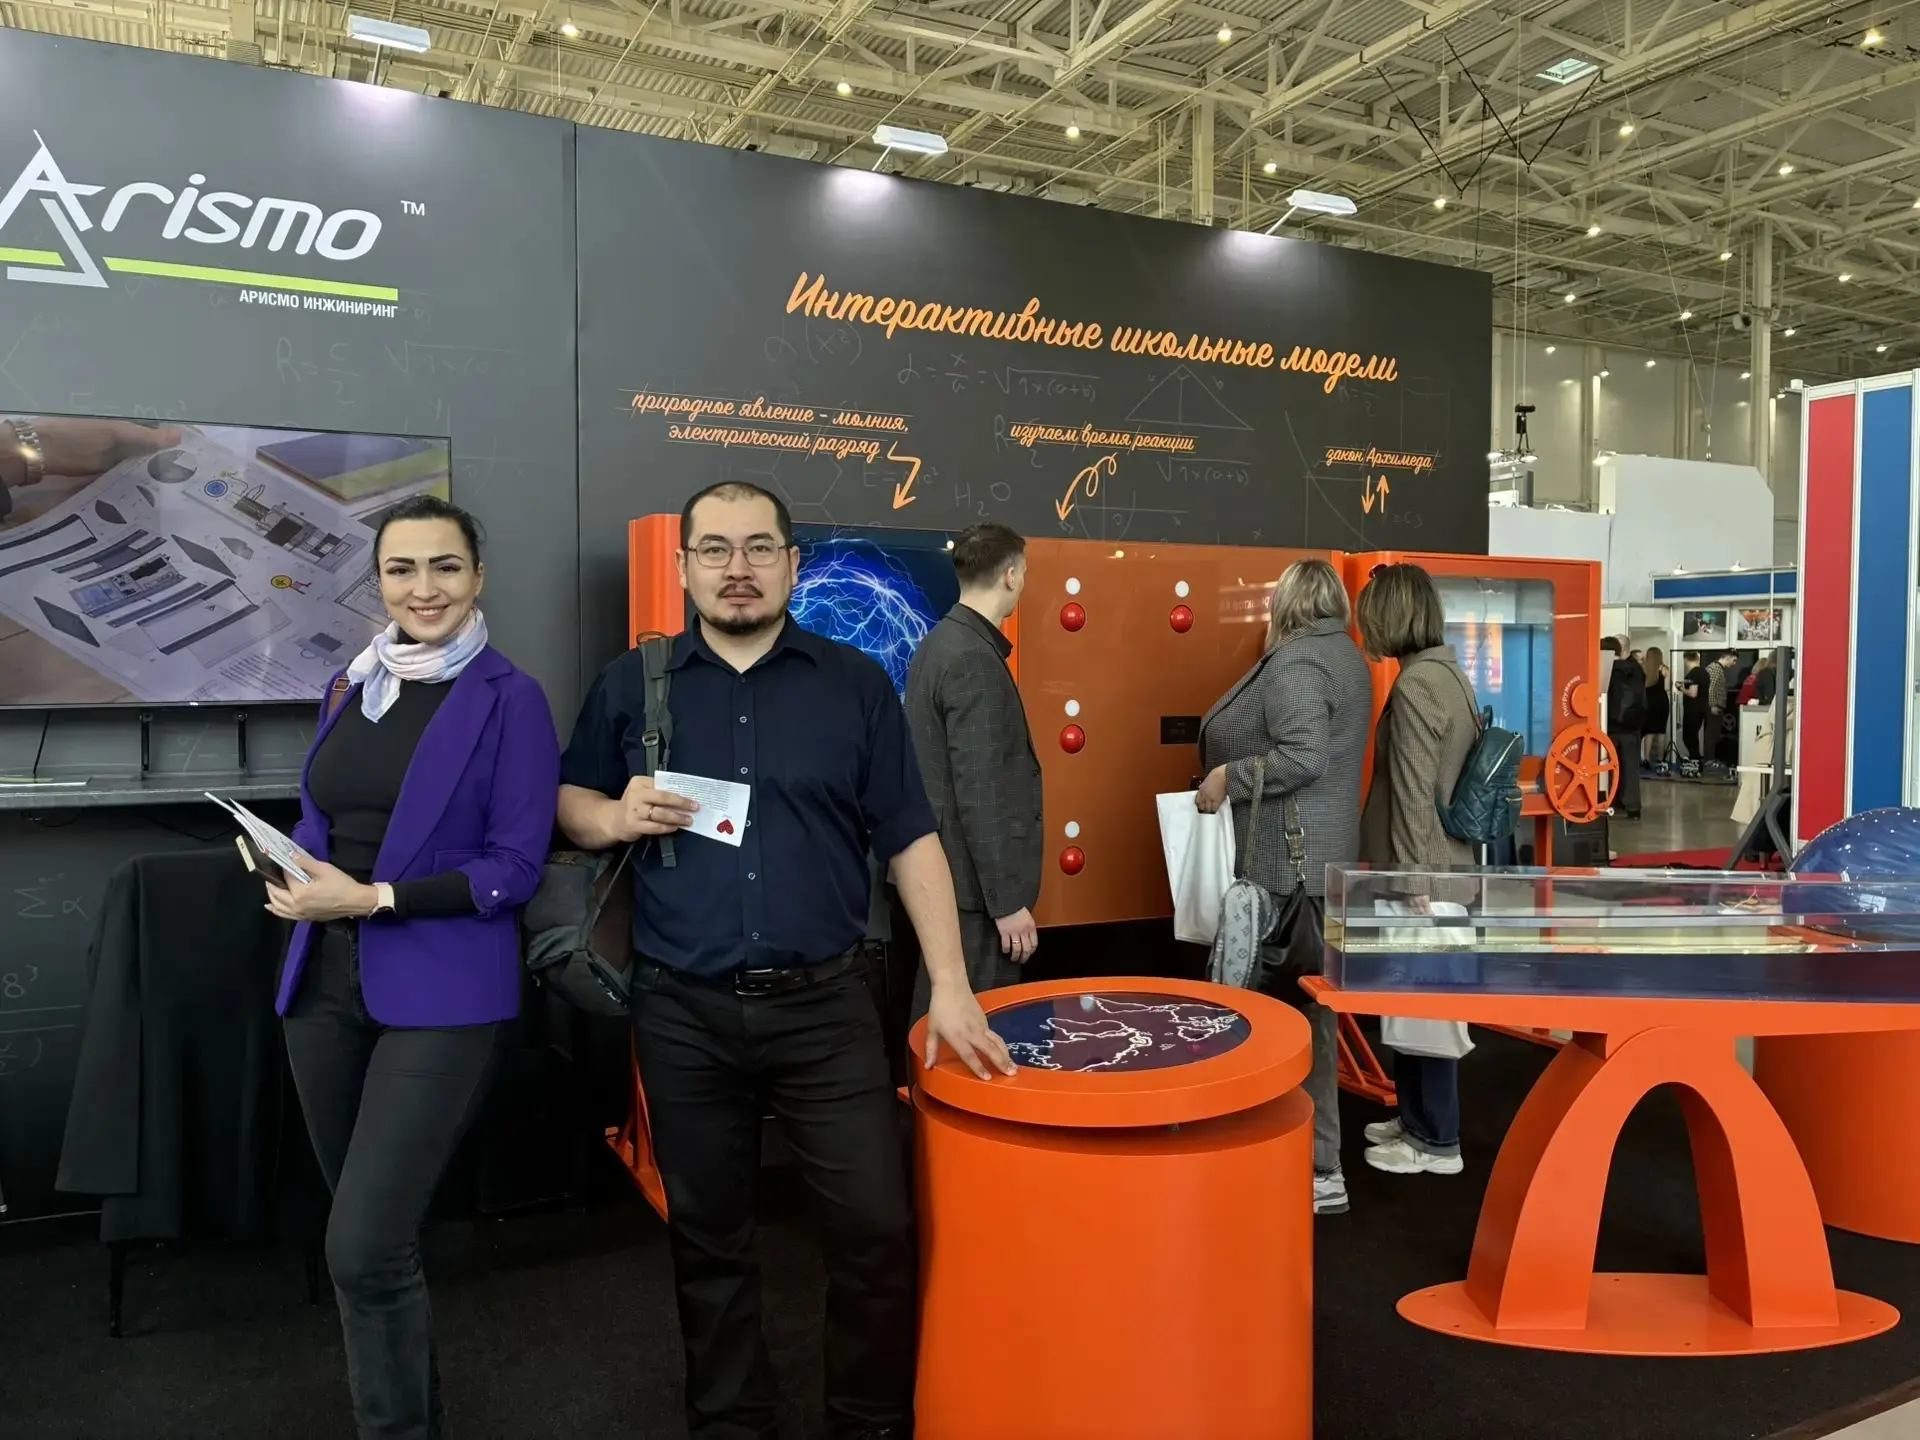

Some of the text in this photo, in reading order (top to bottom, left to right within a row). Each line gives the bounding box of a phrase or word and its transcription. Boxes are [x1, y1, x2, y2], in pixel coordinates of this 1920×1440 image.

[0, 129, 426, 262] Arismo TM
[239, 289, 399, 318] АРИСМО ИНЖИНИРИНГ
[786, 272, 1398, 394] Интерактивные школьные модели
[631, 392, 735, 422] природное
[739, 396, 815, 423] явление
[668, 424, 881, 463] электрический разряд
[1009, 423, 1080, 447] изучаем
[1081, 423, 1132, 447] время
[1131, 434, 1196, 453] реакции
[1325, 447, 1432, 475] закон Архимеда
